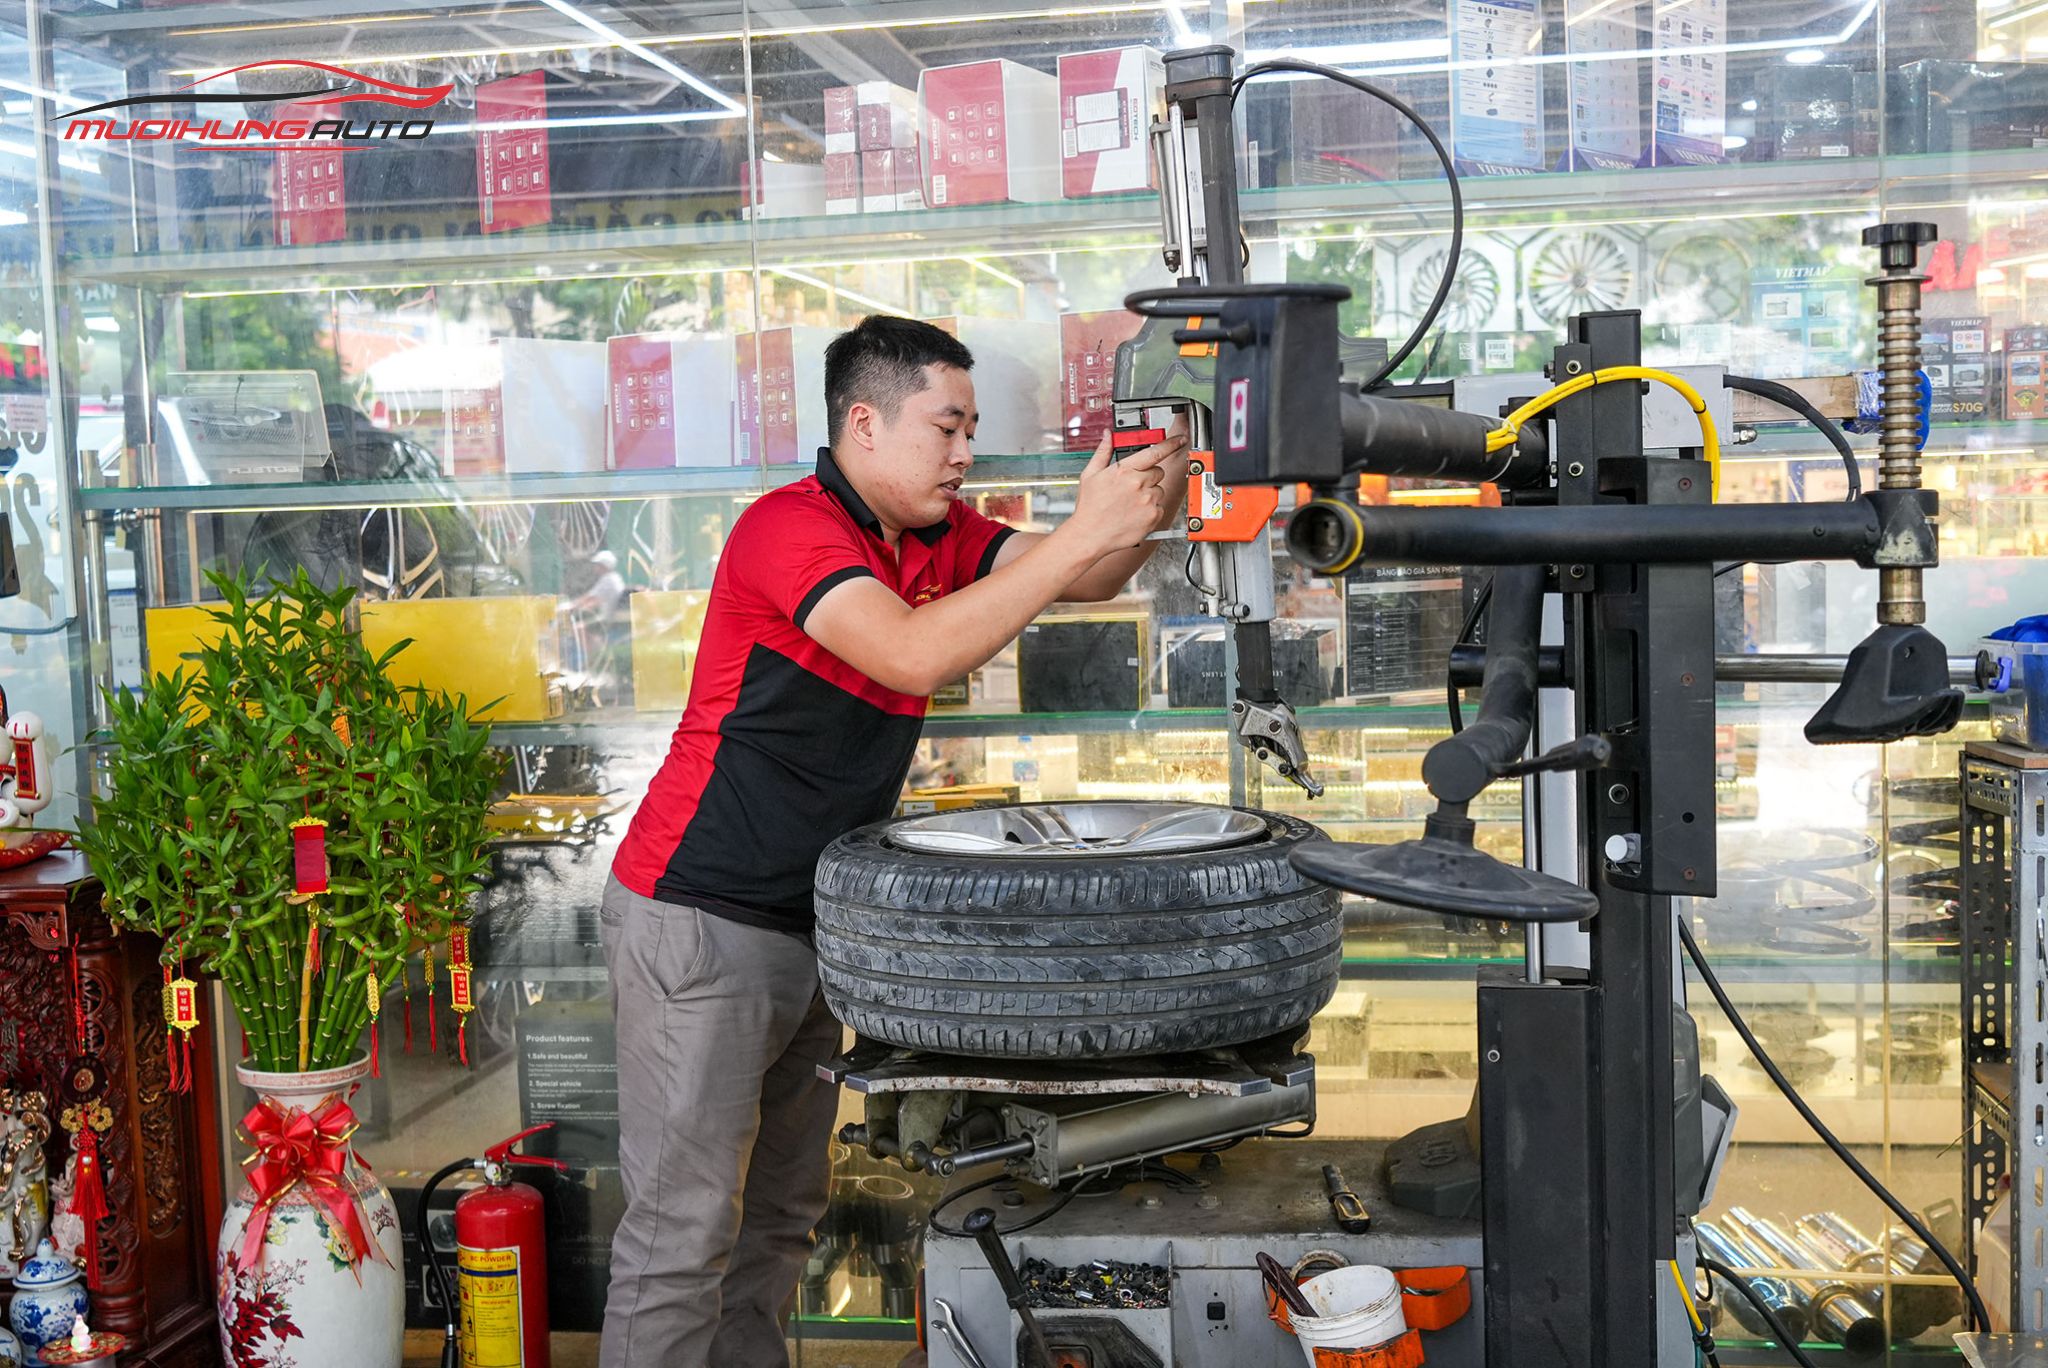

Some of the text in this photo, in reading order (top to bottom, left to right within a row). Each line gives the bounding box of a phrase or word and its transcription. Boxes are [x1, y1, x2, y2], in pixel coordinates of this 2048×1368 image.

[1953, 402, 1983, 413] S70G
[526, 1034, 593, 1042] Product features:
[536, 1080, 558, 1088] Special
[480, 1255, 511, 1263] POWDER
